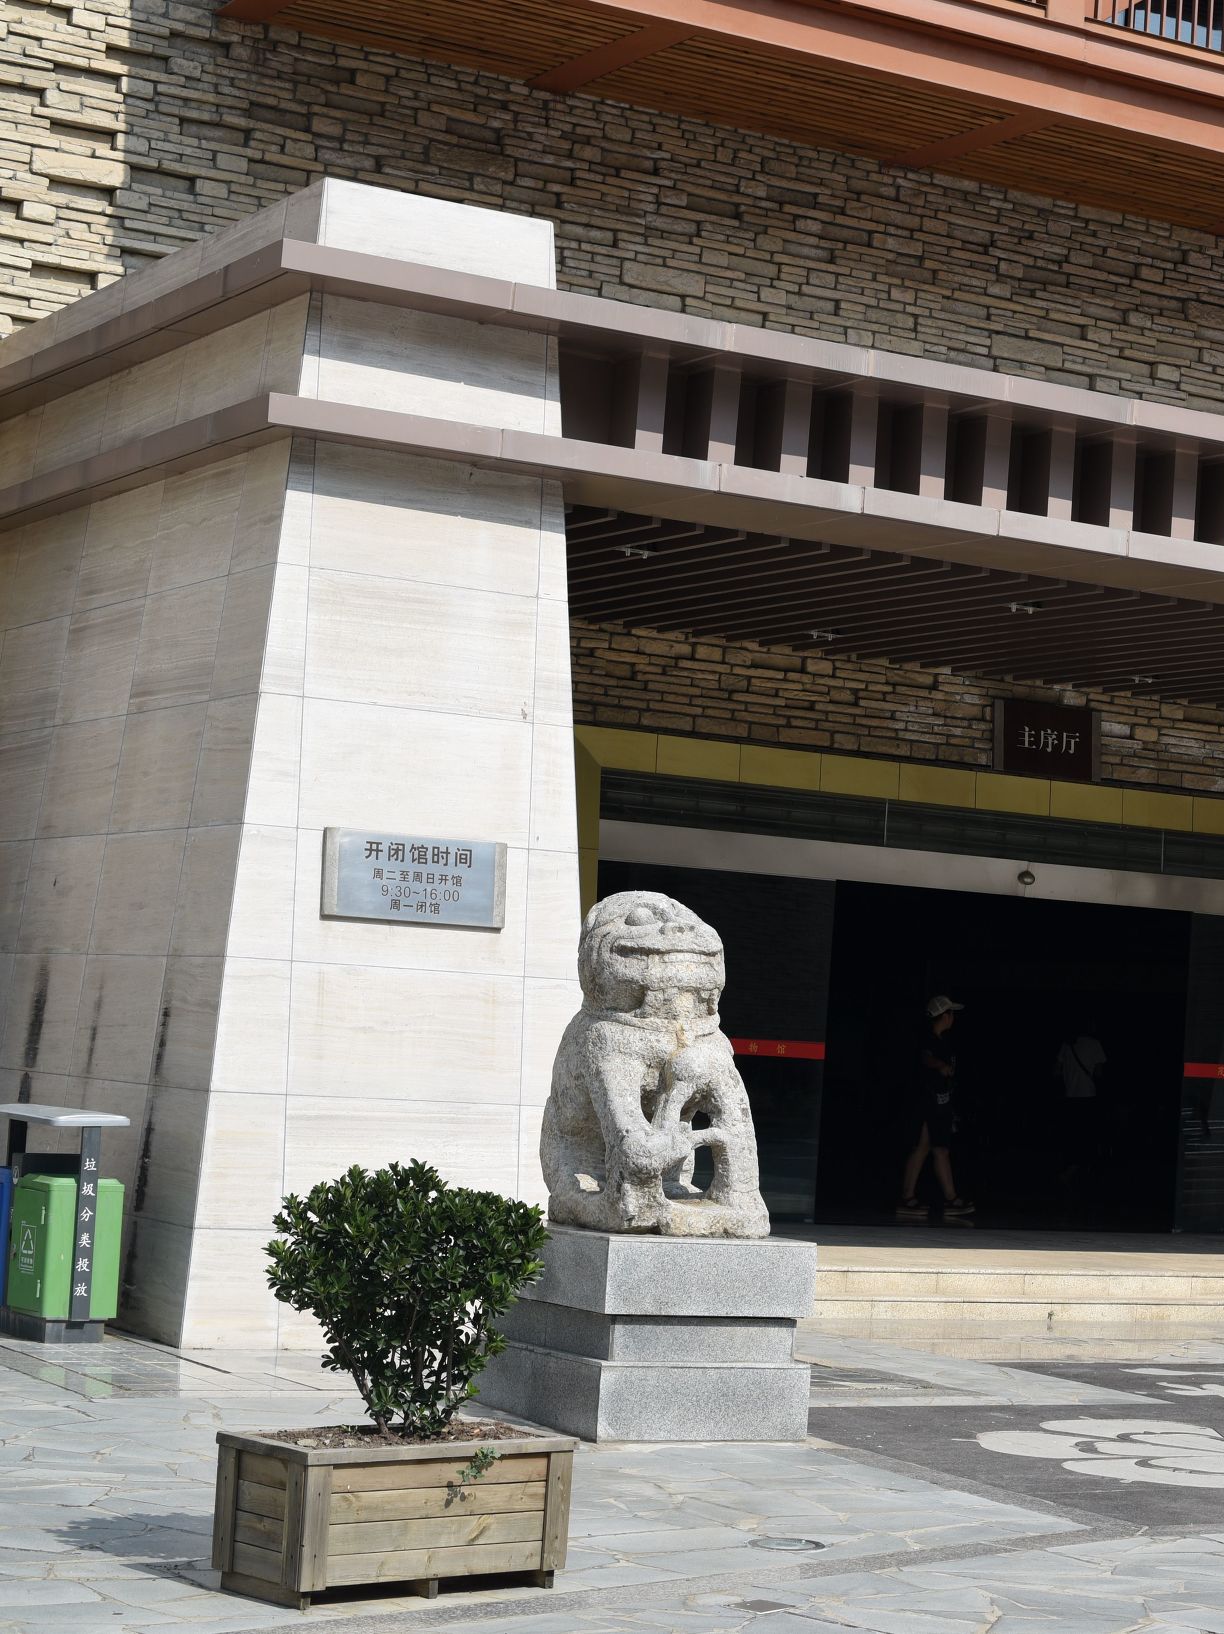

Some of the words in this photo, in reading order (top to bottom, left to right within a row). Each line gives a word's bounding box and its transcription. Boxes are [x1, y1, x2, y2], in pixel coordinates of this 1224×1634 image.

[1017, 726, 1080, 754] 主序厅
[365, 841, 472, 868] 开闭馆时间
[372, 868, 463, 887] 周二至周日开馆
[390, 899, 440, 915] 周一闭馆
[73, 1158, 97, 1297] 垃圾分类投放
